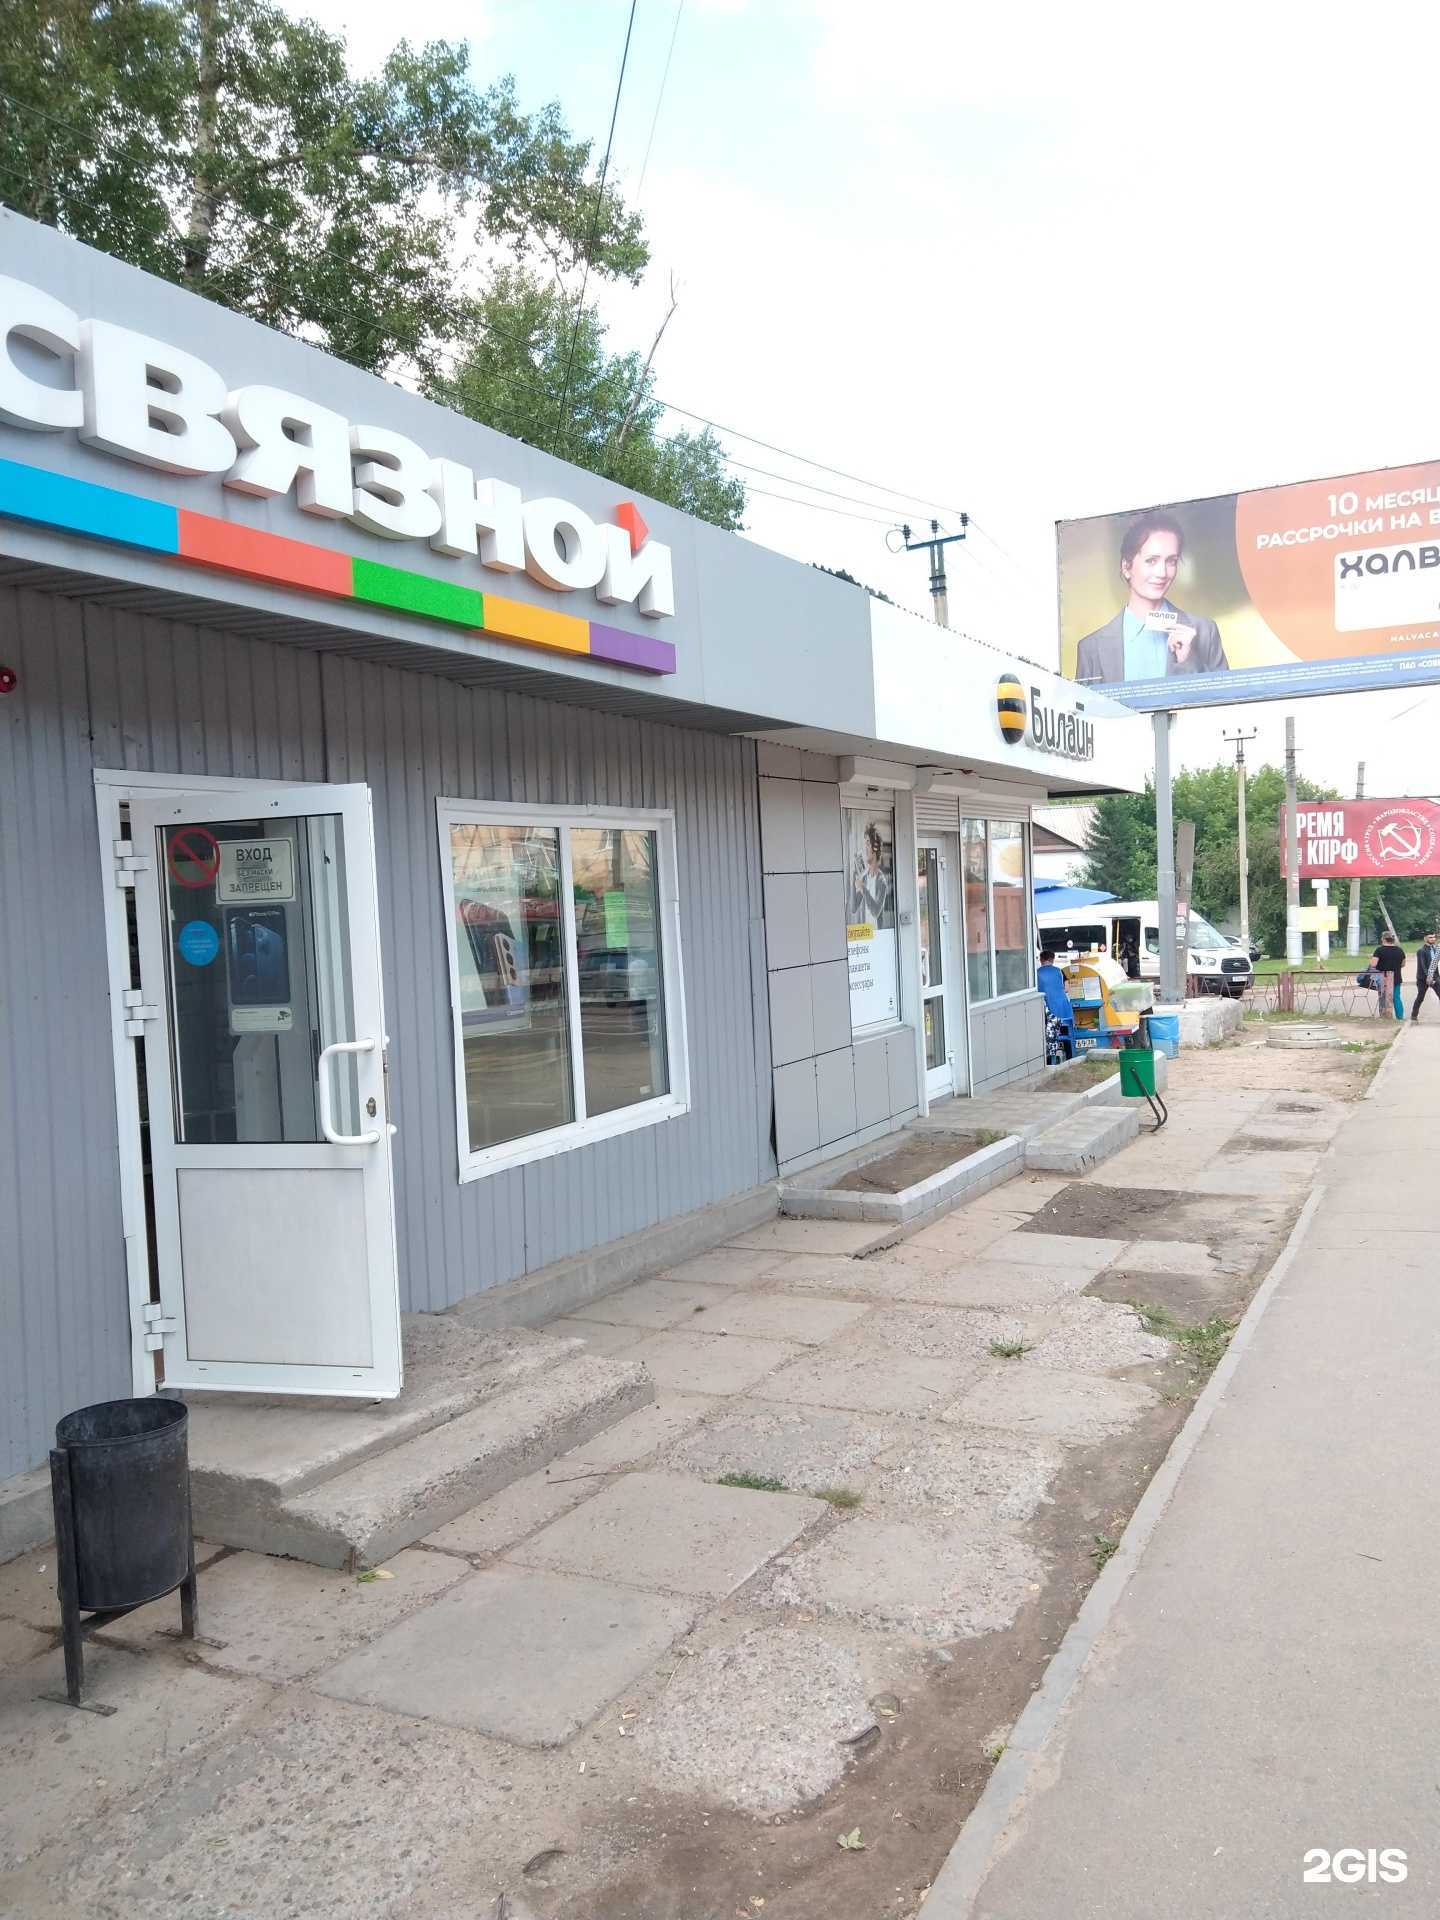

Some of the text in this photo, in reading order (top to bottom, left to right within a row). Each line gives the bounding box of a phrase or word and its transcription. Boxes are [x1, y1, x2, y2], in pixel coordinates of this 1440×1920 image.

[0, 274, 675, 619] СВЯЗНОЙ
[1327, 491, 1358, 517] 10
[1256, 517, 1384, 550] РАССРОЧКИ
[1390, 511, 1423, 530] НА
[1030, 686, 1095, 759] Билайн
[1285, 810, 1345, 839] РЕМЯ
[236, 847, 273, 863] ВХОД
[1307, 838, 1359, 866] КПРФ
[229, 881, 283, 893] ЗАПРЕЩЕН
